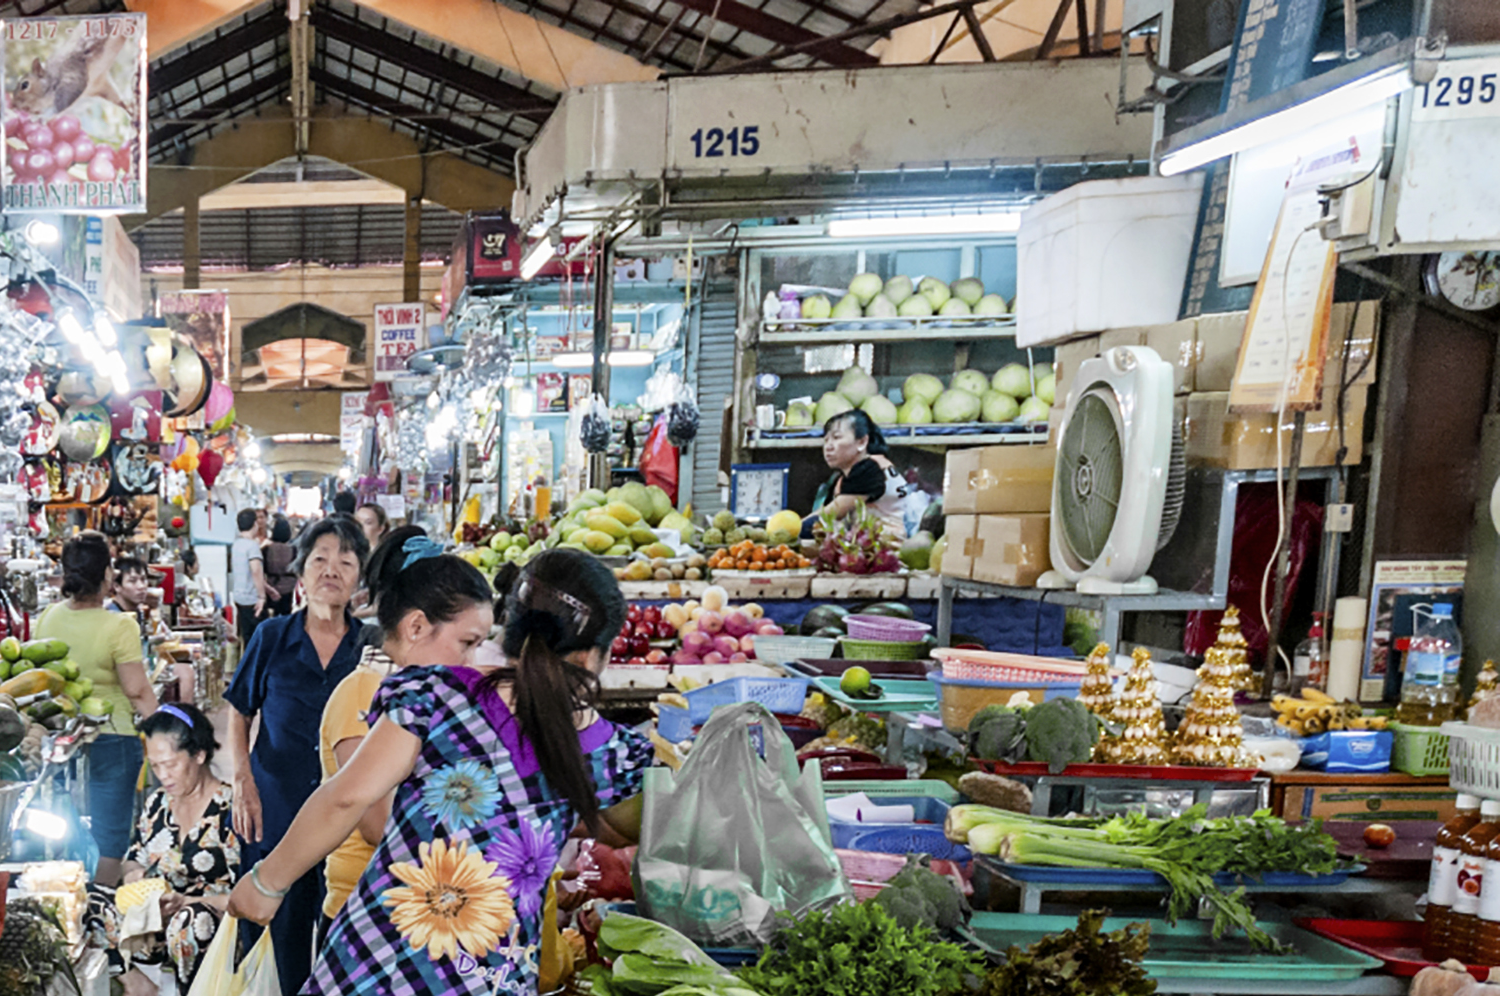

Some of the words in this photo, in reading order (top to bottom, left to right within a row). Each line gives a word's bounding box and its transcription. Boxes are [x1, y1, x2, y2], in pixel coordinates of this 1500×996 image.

[7, 22, 57, 40] 1217
[85, 18, 138, 37] 1175
[1422, 73, 1497, 108] 1295
[690, 125, 760, 158] 1215
[7, 175, 79, 208] THÀNH
[381, 328, 417, 341] COFFEE
[381, 342, 417, 356] TEA
